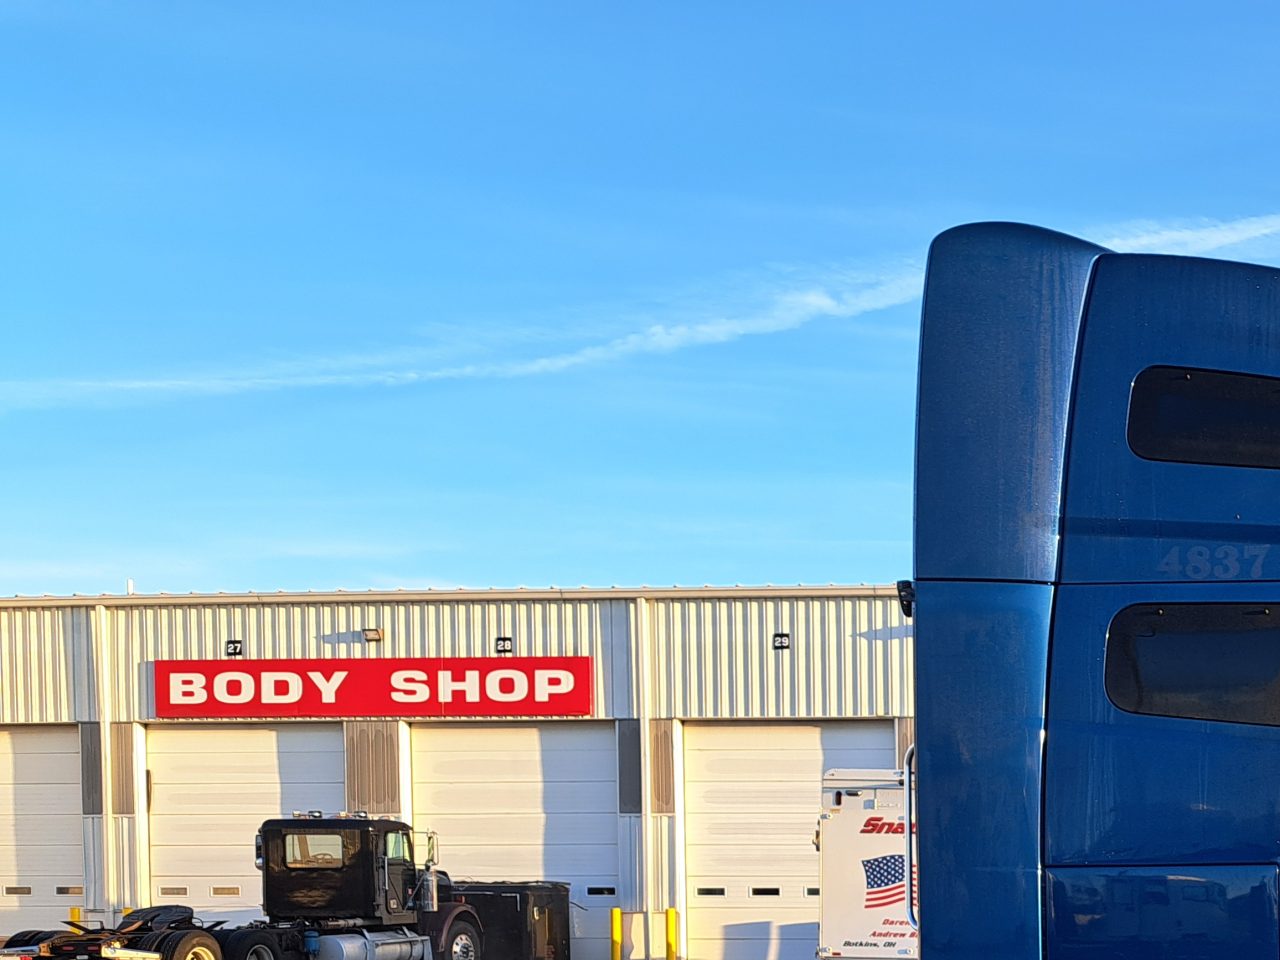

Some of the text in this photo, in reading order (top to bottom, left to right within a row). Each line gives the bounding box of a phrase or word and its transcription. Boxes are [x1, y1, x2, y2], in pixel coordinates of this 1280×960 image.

[1157, 544, 1271, 578] 4837
[497, 640, 512, 651] 28
[774, 637, 789, 647] 29
[227, 643, 242, 653] 27
[169, 669, 575, 704] BODY SHOP
